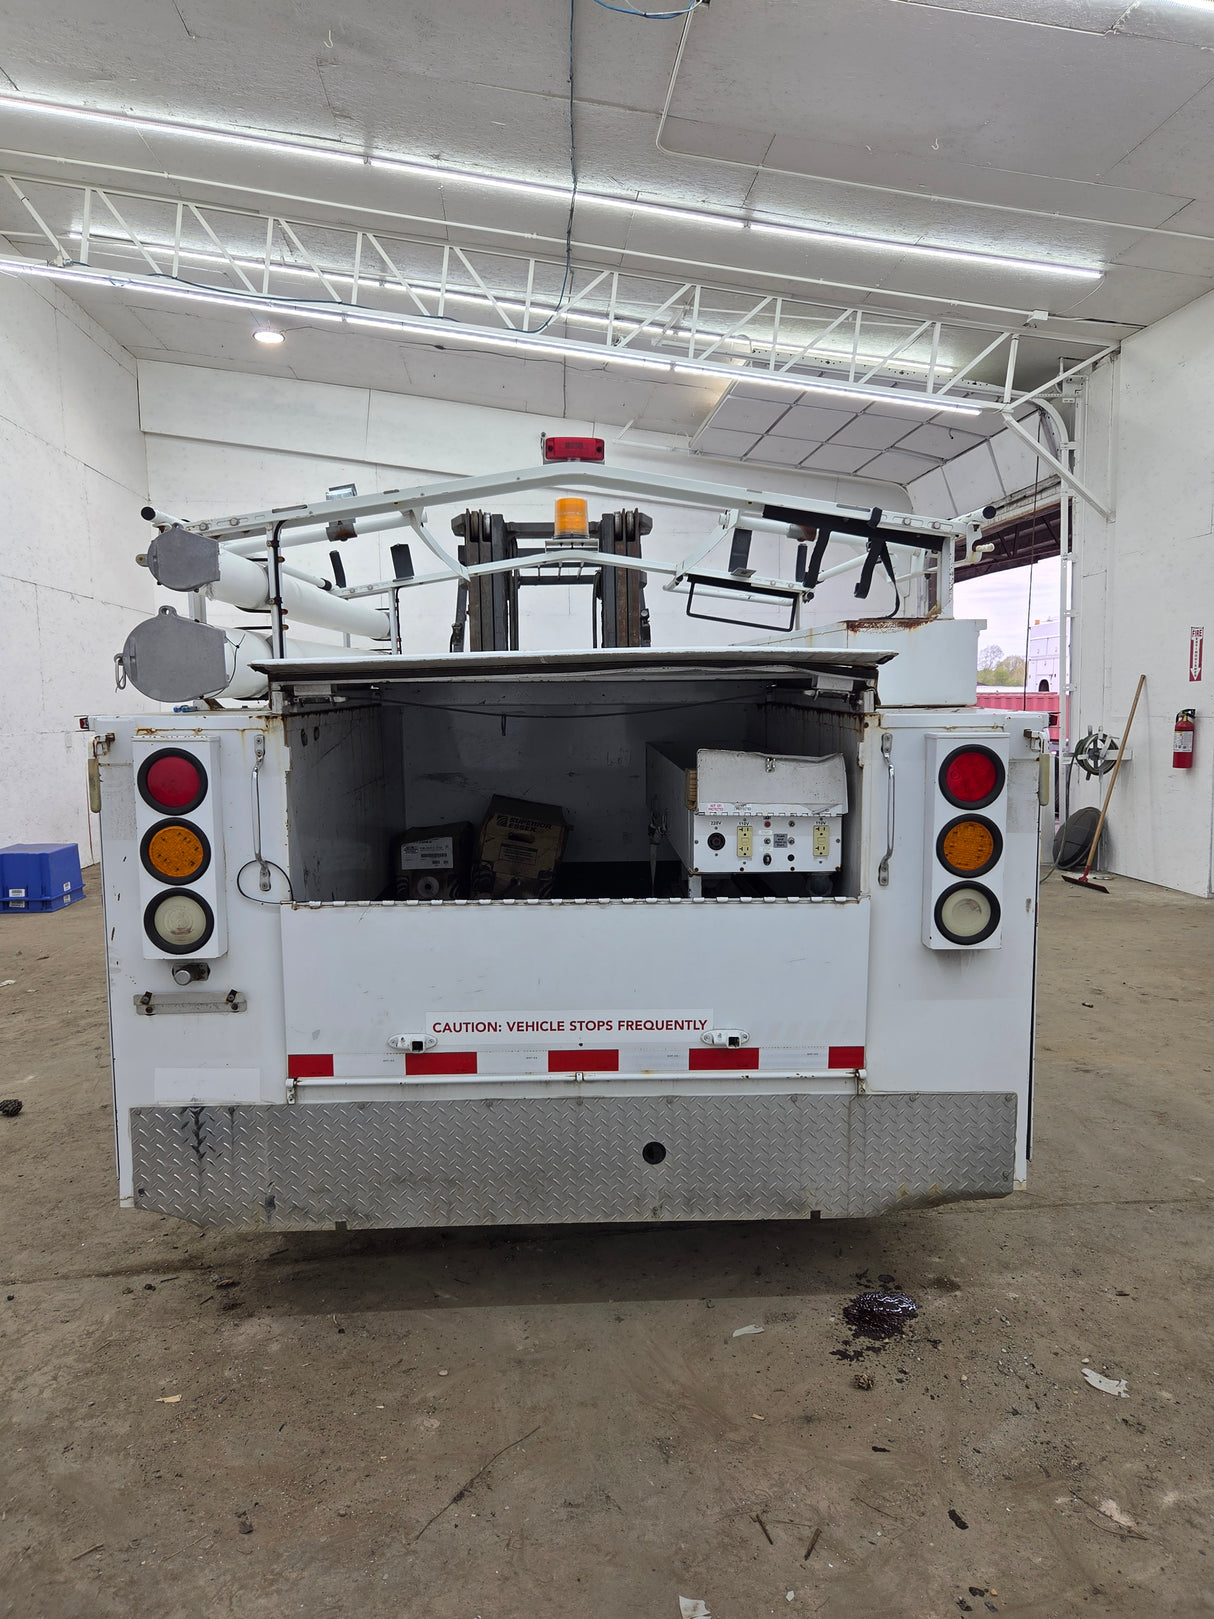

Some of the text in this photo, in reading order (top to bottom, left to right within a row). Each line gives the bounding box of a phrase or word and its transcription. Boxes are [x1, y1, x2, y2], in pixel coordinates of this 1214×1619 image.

[1192, 629, 1203, 637] FIRE
[509, 822, 537, 833] ESSEX
[510, 816, 552, 830] SUPERIOR
[432, 1019, 708, 1034] CAUTION: VEHICLE STOPS FREQUENTLY
